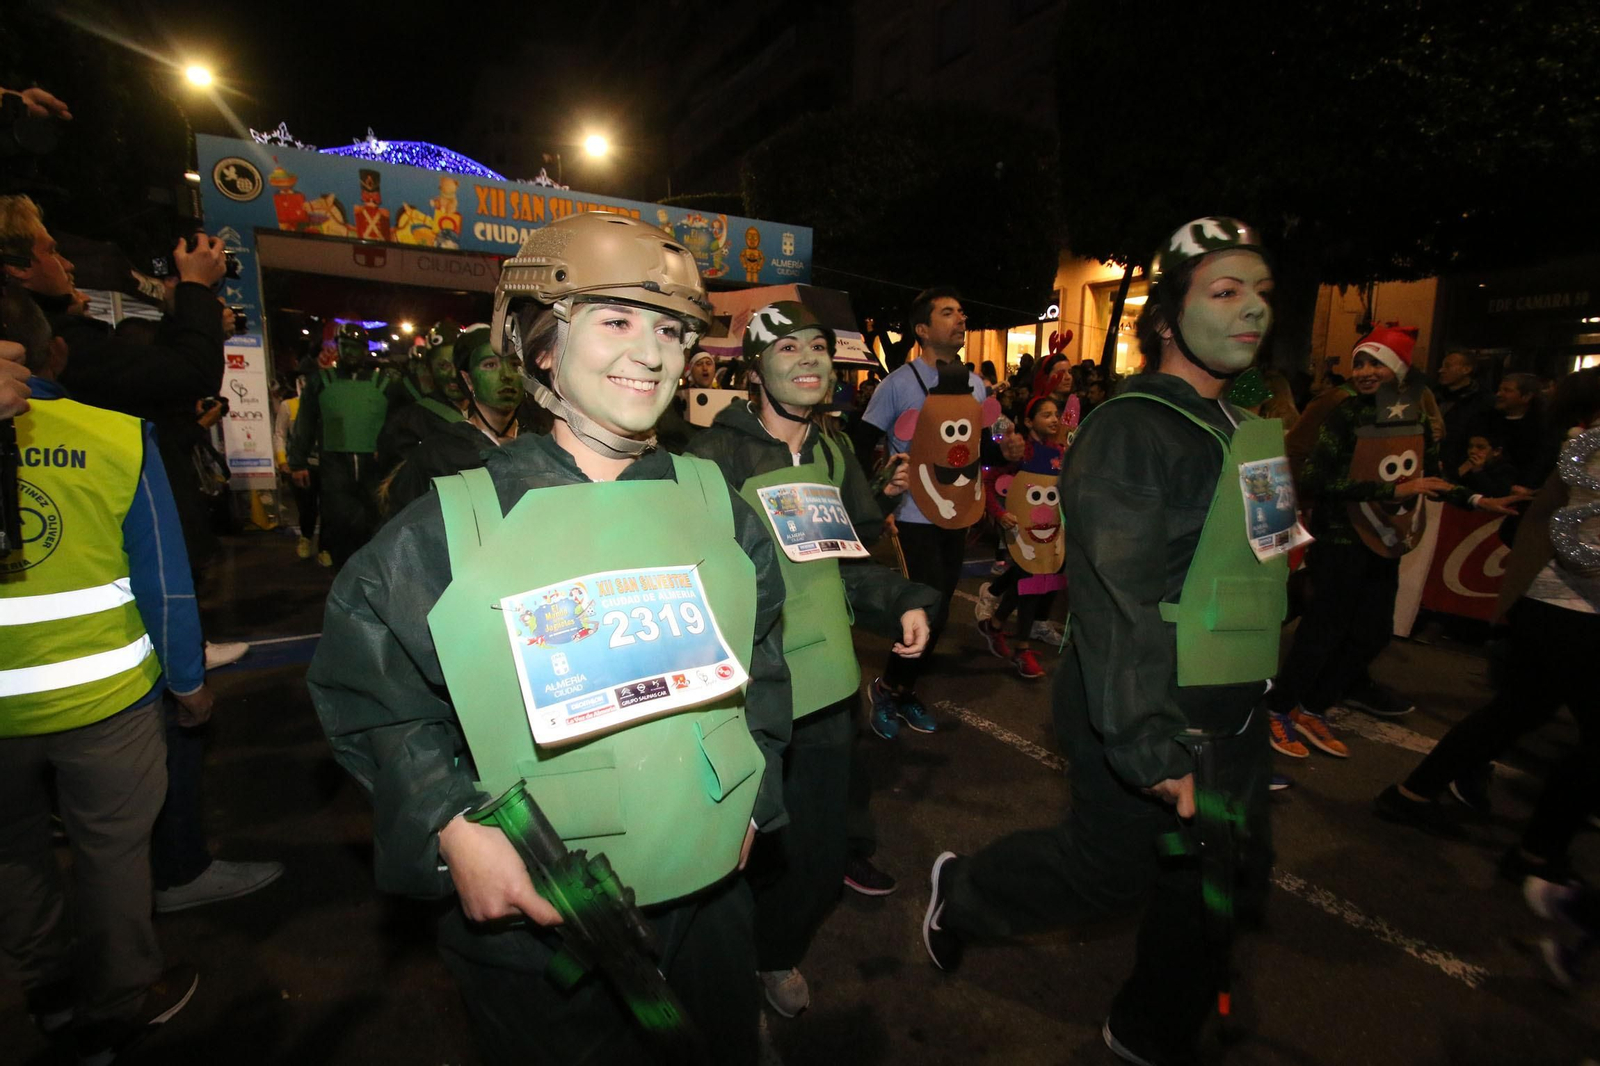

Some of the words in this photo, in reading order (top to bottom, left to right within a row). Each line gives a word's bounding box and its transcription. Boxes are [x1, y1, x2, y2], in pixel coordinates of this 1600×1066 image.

[474, 184, 507, 219] XII
[509, 190, 546, 223] SAN
[417, 255, 487, 278] CIUDAD
[42, 514, 58, 549] OLIVER
[597, 579, 615, 598] XII
[614, 575, 640, 594] SAN
[640, 573, 693, 592] SILVESTRE
[602, 595, 641, 609] CIUDAD
[643, 593, 656, 602] DE
[659, 590, 697, 601] ALMERÍA
[602, 601, 706, 649] 2319
[544, 673, 588, 694] ALMERÍA
[554, 684, 584, 699] CIUDAD
[621, 696, 639, 708] GRUPO
[657, 690, 668, 698] CAR
